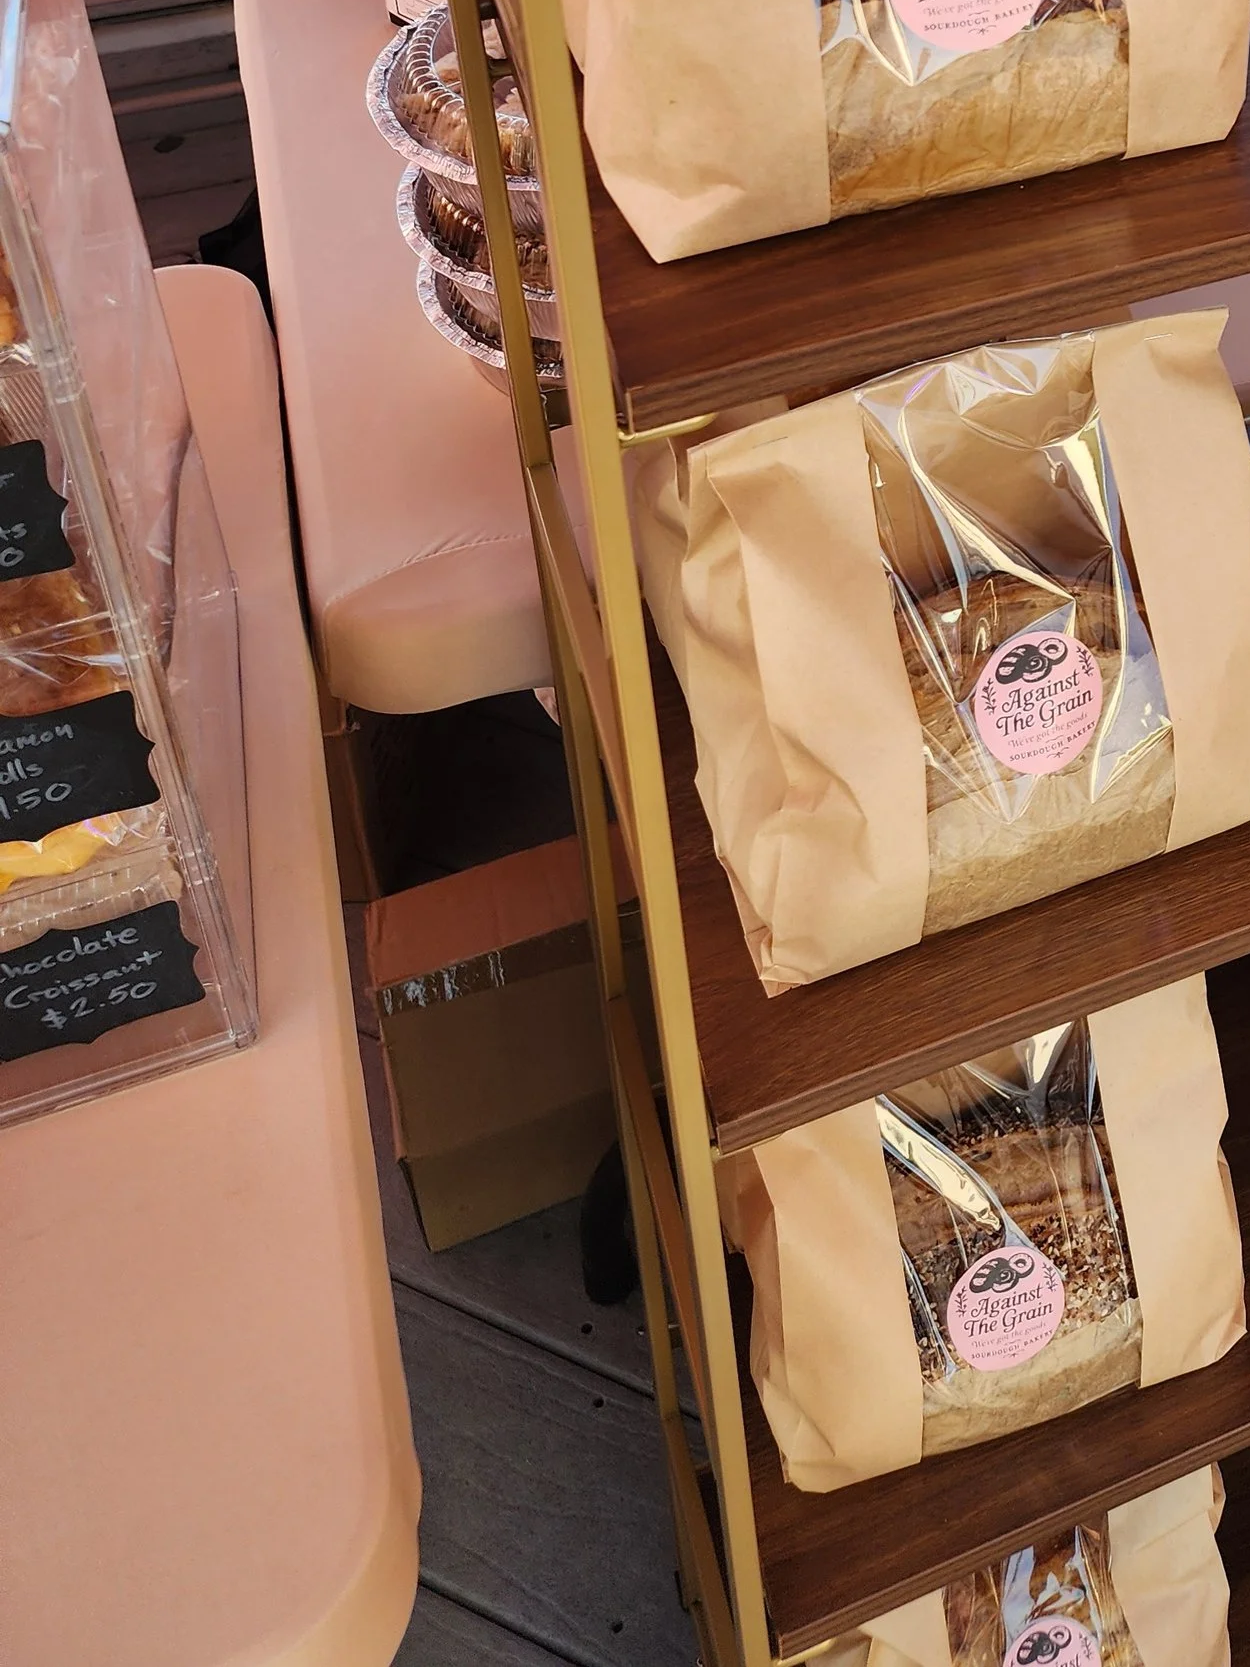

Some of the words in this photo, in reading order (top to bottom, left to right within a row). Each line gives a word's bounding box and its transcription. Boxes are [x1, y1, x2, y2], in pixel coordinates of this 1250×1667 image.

[924, 17, 989, 31] SOURDOUGH
[995, 3, 1034, 21] BAKERY
[1002, 669, 1080, 713] Against
[996, 712, 1034, 737] The
[1040, 689, 1093, 728] Grain
[1009, 741, 1063, 762] SOURDOUGH
[1067, 720, 1095, 743] BAKERY
[0, 927, 139, 984] hocolate
[4, 950, 163, 1010] Croissant
[963, 1317, 998, 1338] The
[1002, 1302, 1054, 1333] Grain
[970, 1284, 1043, 1318] Against
